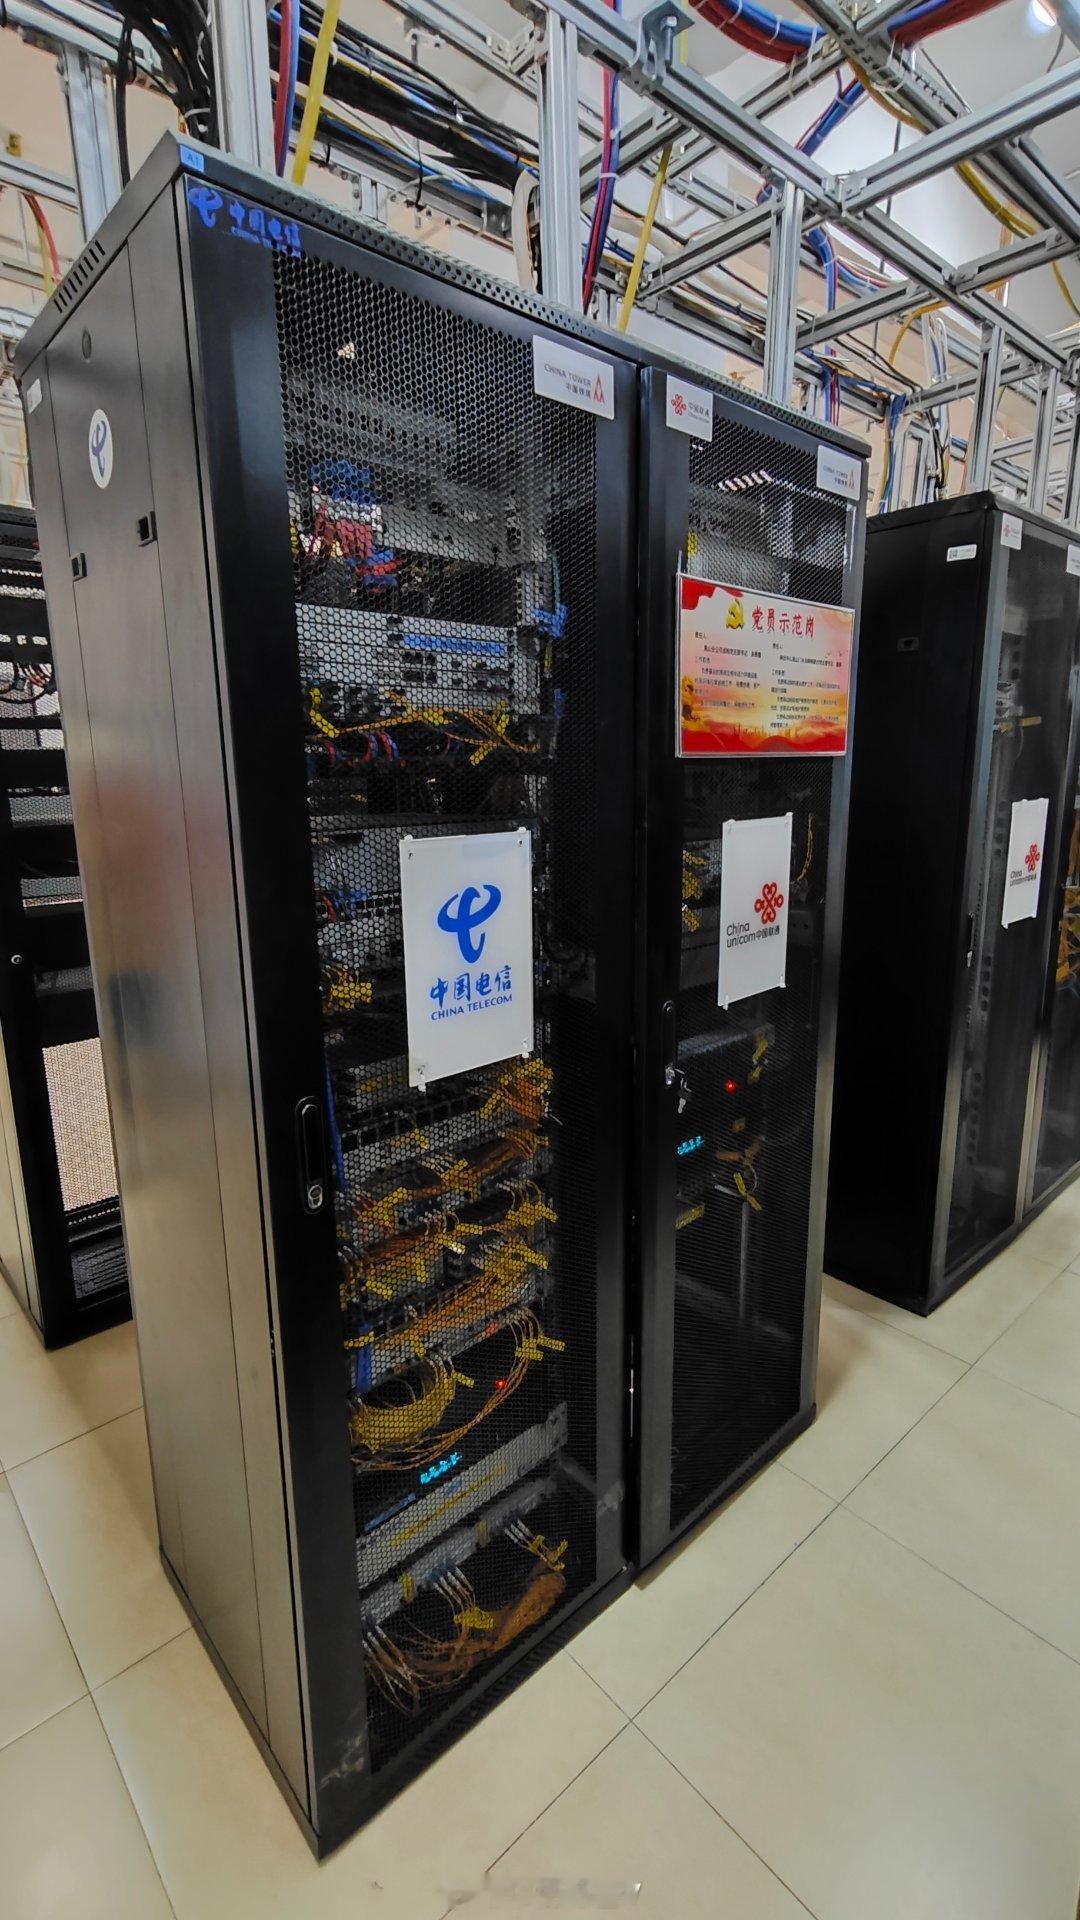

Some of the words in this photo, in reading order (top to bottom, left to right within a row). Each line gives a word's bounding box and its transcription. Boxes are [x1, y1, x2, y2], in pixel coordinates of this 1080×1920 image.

[544, 363, 566, 379] CHINA
[568, 371, 592, 386] TOWER
[751, 605, 815, 639] 党员示范岗
[726, 922, 750, 937] China
[726, 932, 756, 948] unicom
[429, 964, 512, 1009] 中国电信
[431, 1006, 465, 1021] CHINA
[467, 994, 513, 1012] TELECOM
